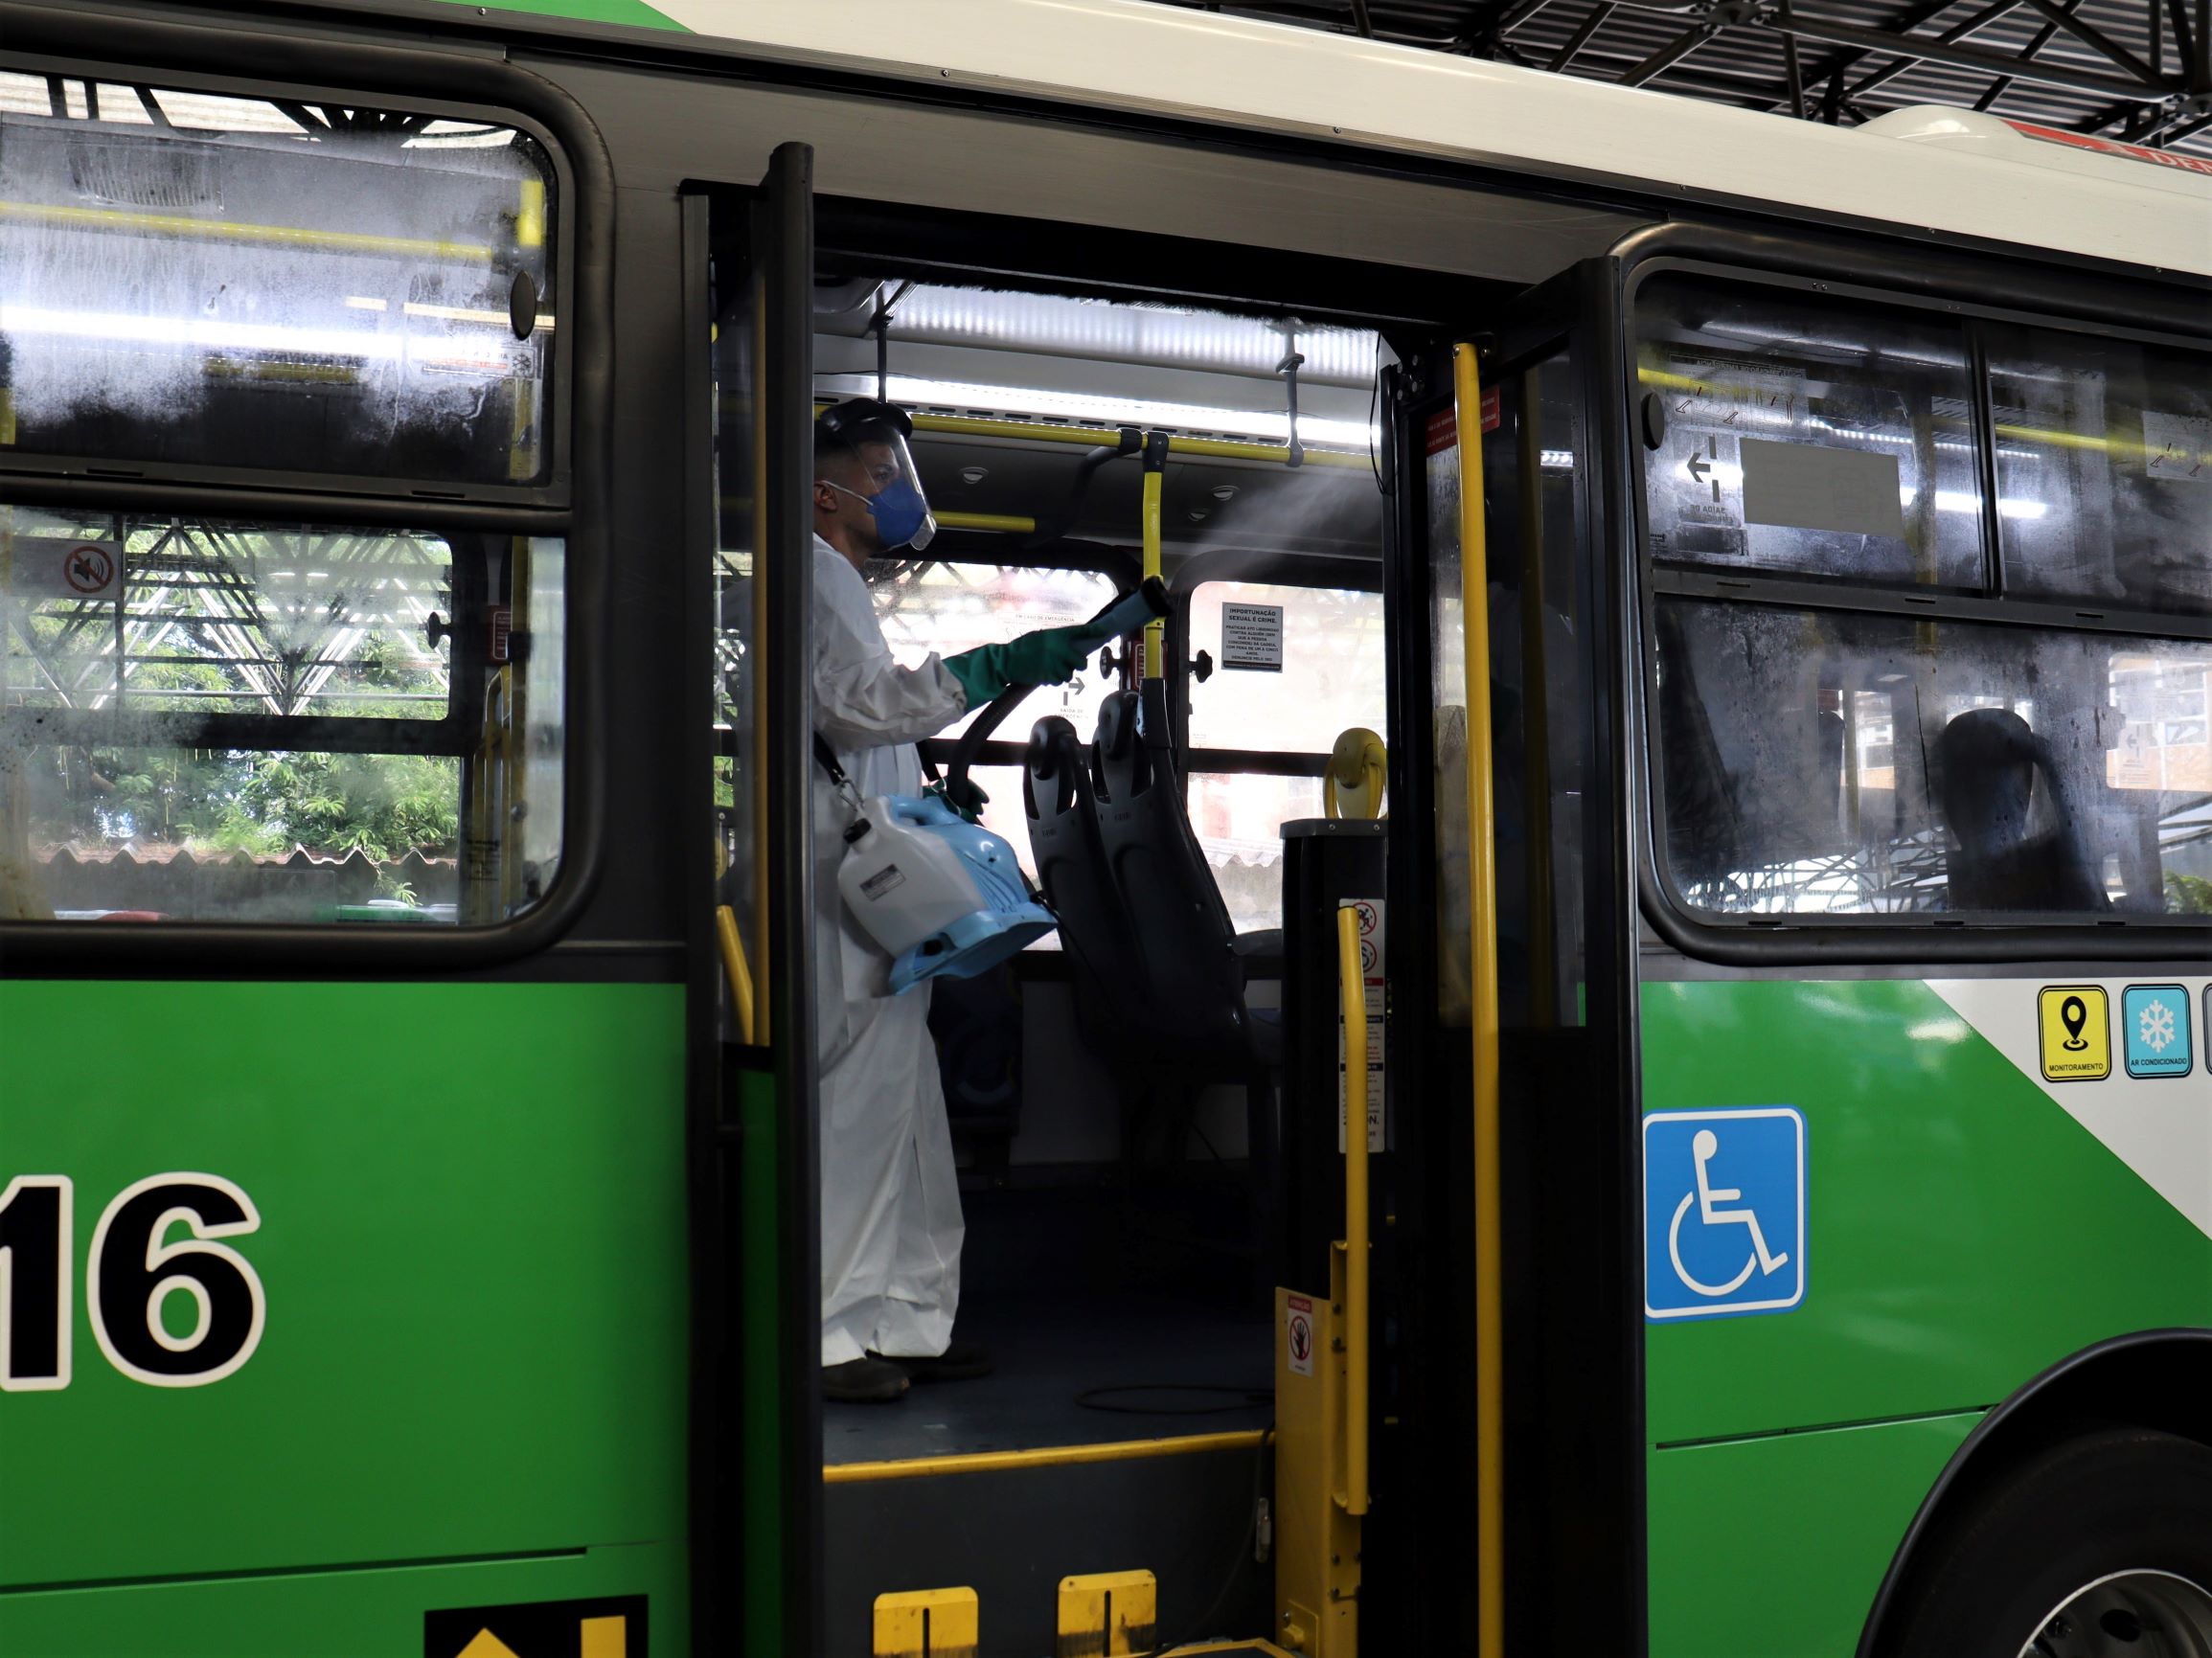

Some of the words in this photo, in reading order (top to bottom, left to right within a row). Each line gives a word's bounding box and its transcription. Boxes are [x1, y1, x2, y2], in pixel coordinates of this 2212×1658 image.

[1229, 608, 1276, 617] IMPORTUNAÇÃO
[2048, 1062, 2104, 1072] MONITORAMENTO
[2130, 1058, 2140, 1067] AR
[2140, 1057, 2188, 1067] CONDICIONADO
